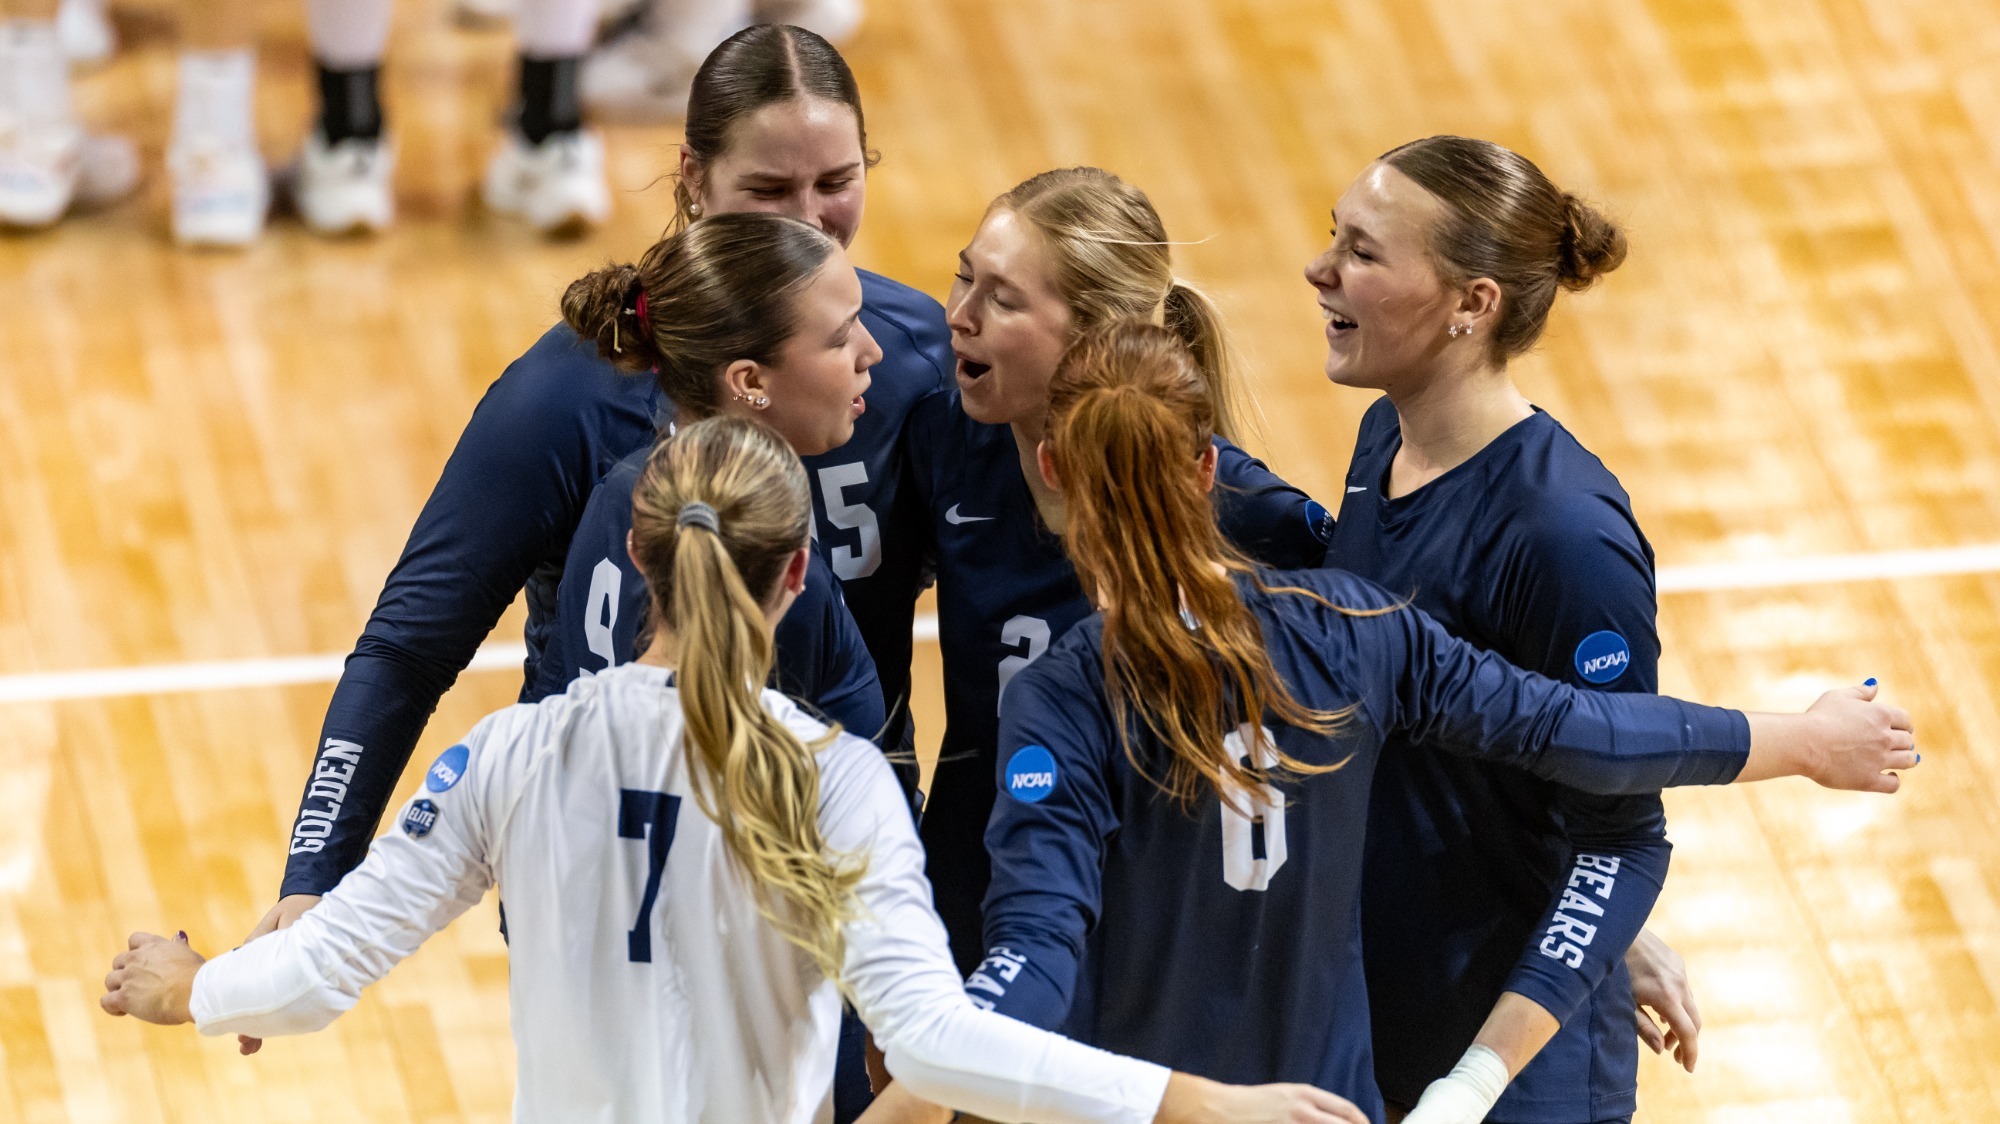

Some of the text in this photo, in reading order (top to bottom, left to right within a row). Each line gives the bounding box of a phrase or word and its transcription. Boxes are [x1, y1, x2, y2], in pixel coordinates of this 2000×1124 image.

[809, 461, 882, 581] 5
[579, 557, 622, 676] 9
[1584, 650, 1627, 674] NCAA
[289, 737, 364, 855] GOLDEN
[407, 806, 436, 828] ELITE
[431, 760, 458, 787] NCAA
[1012, 771, 1053, 789] NCAA
[618, 787, 682, 963] 7
[1539, 854, 1621, 969] BEARS
